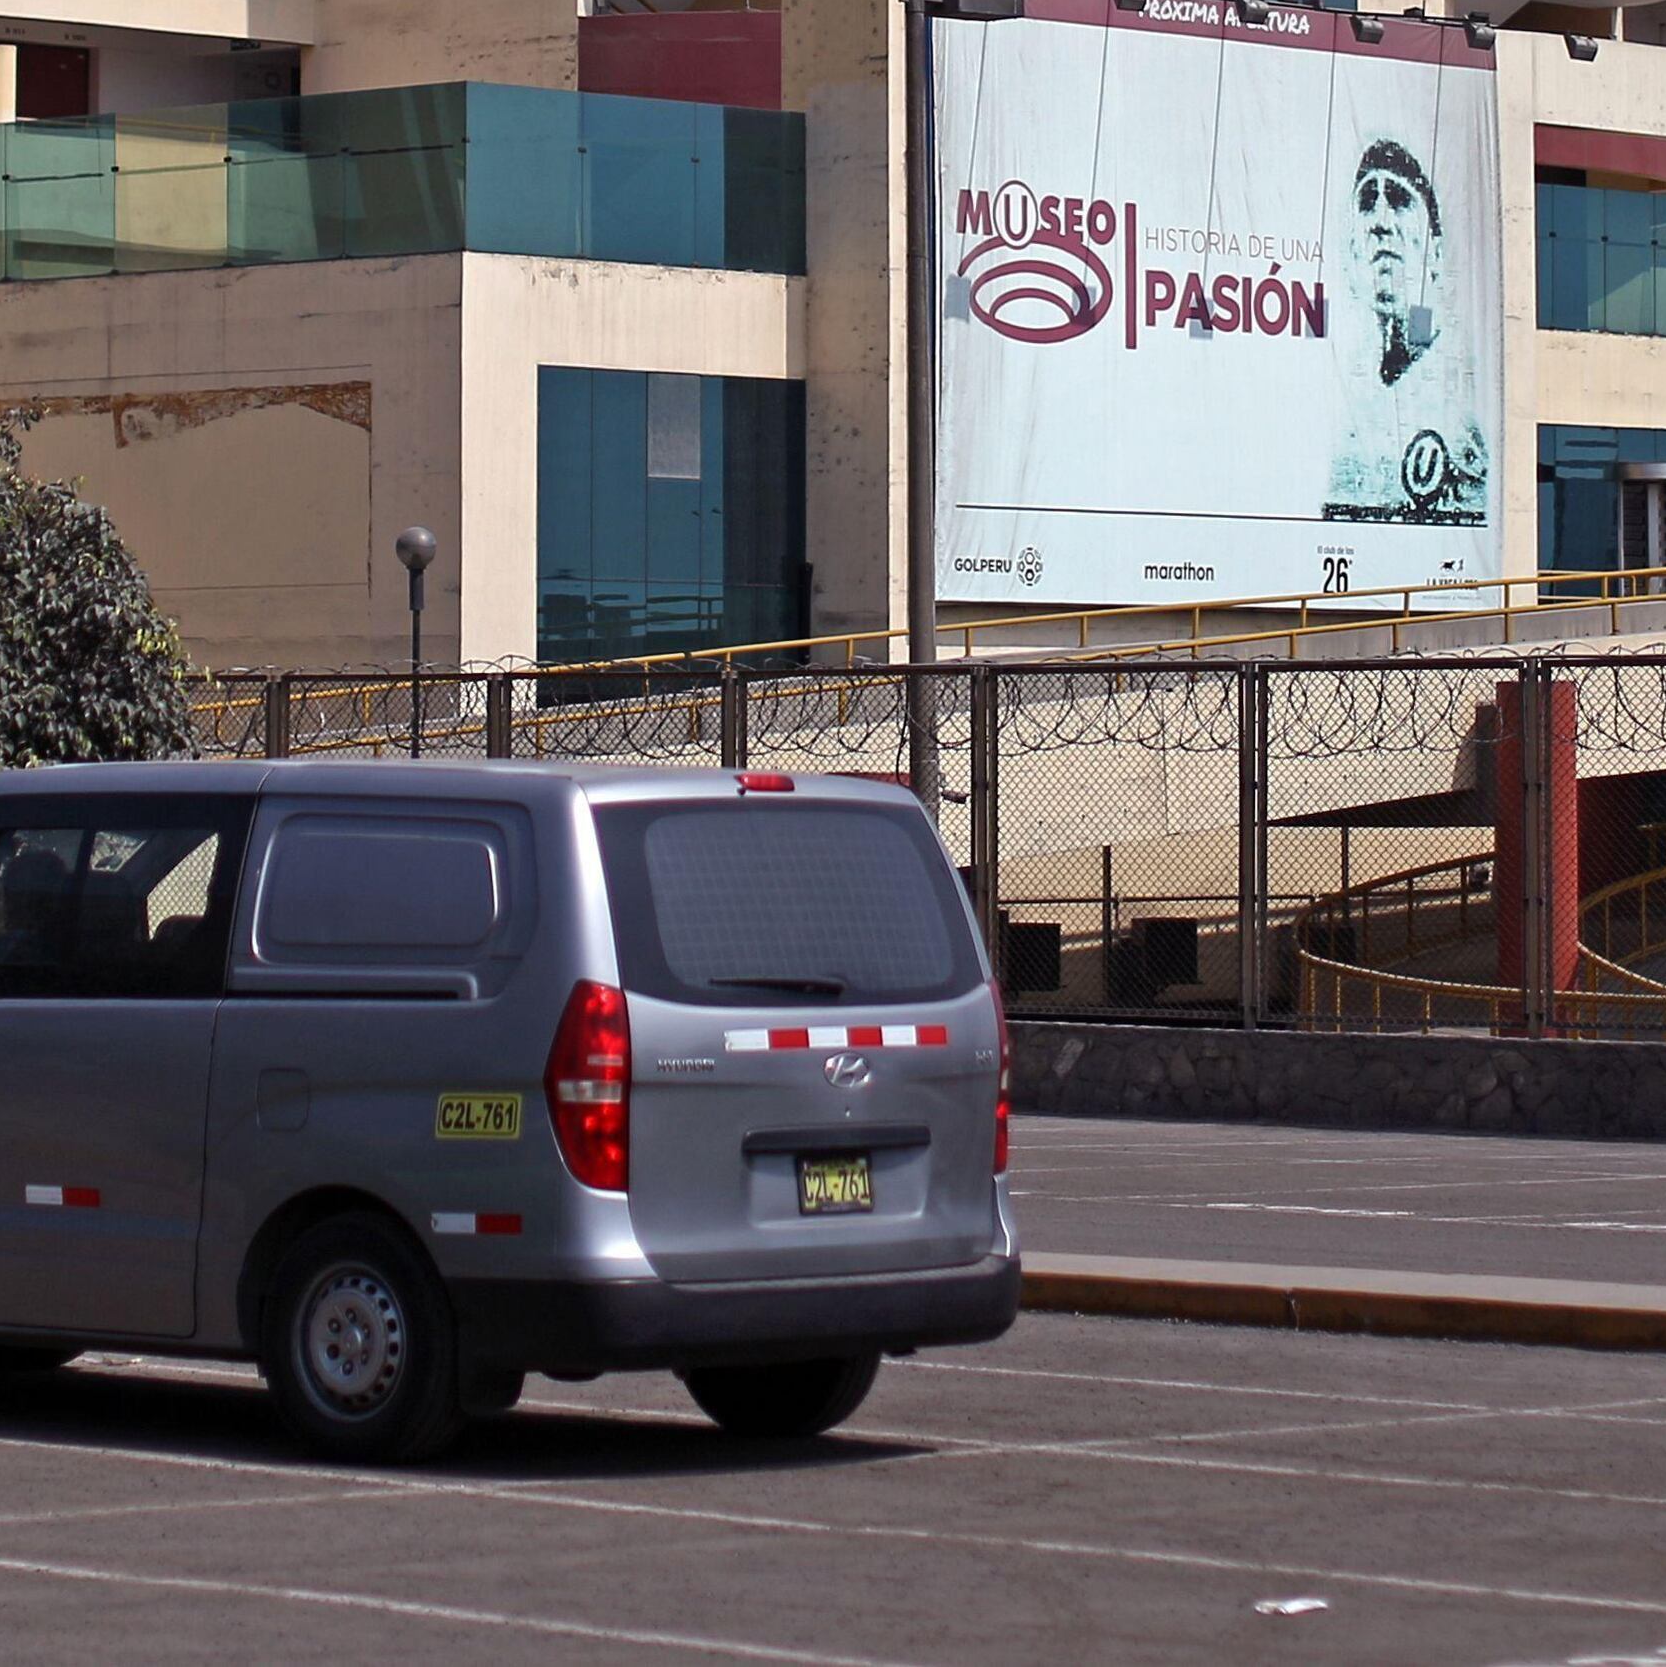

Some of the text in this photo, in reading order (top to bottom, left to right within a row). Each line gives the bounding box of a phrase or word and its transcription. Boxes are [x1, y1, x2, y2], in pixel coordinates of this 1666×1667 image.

[1224, 1, 1311, 36] ATURA
[956, 182, 1116, 247] MUSEO
[1145, 227, 1325, 263] HISTORIA DE UNA
[1144, 262, 1325, 339] PASIÓN
[954, 558, 1012, 573] GOLPERU
[1144, 562, 1214, 581] marathon
[441, 1101, 514, 1130] C2L-761
[803, 1167, 872, 1201] C2L-761
